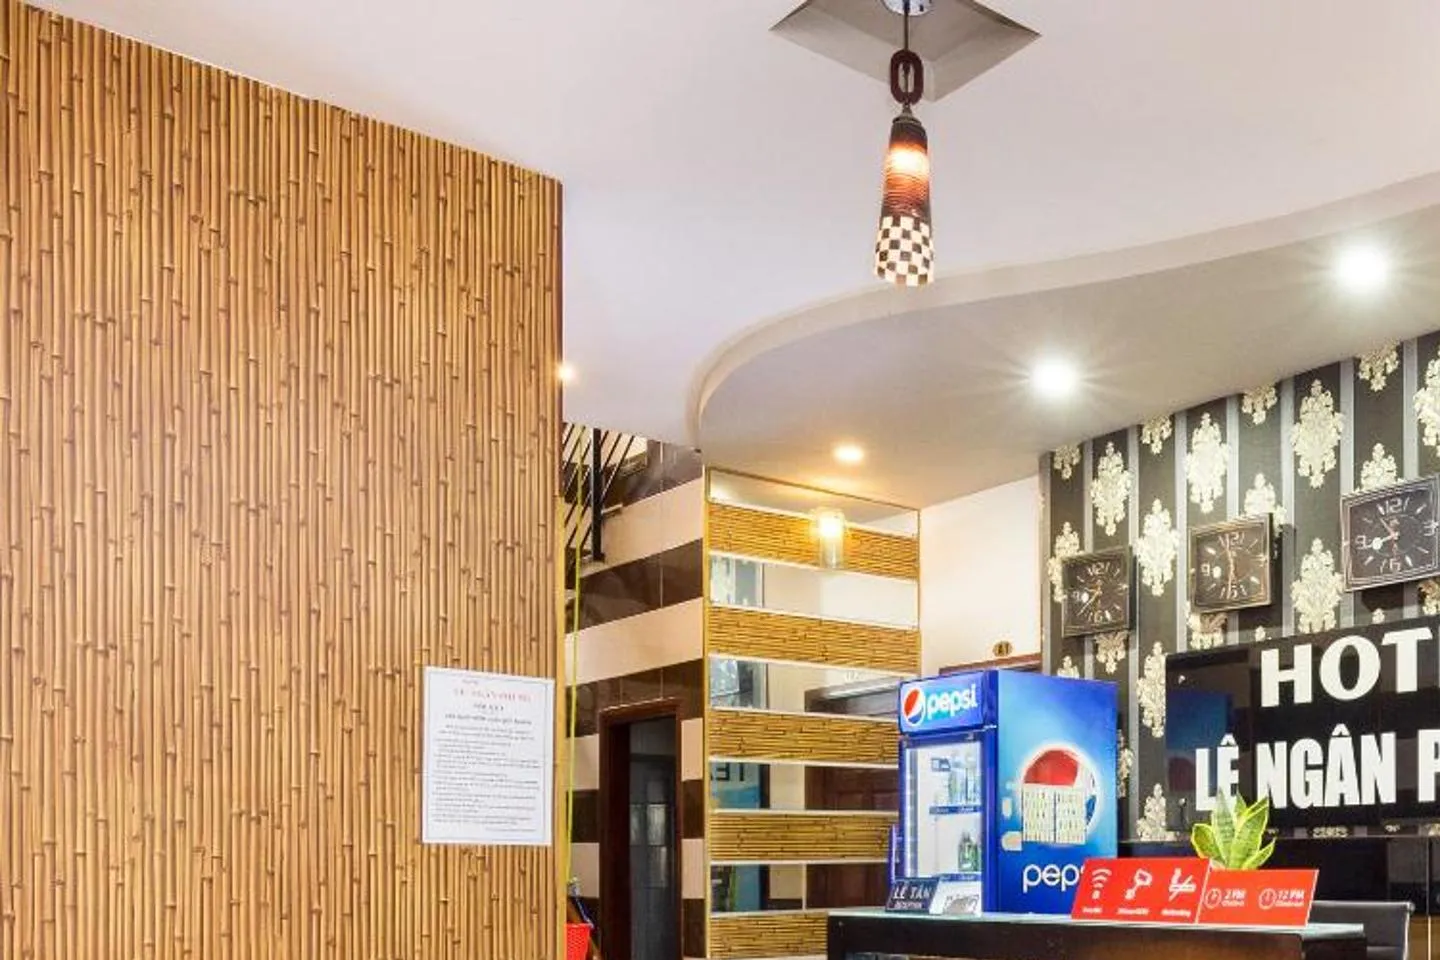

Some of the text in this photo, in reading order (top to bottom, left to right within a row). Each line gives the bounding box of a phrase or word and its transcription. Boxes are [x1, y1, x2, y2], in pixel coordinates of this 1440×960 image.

[1385, 498, 1402, 514] 12
[927, 683, 978, 720] pepsi
[1195, 734, 1240, 812] LÊ
[1256, 723, 1397, 810] NGÂN
[1023, 863, 1085, 893] pep
